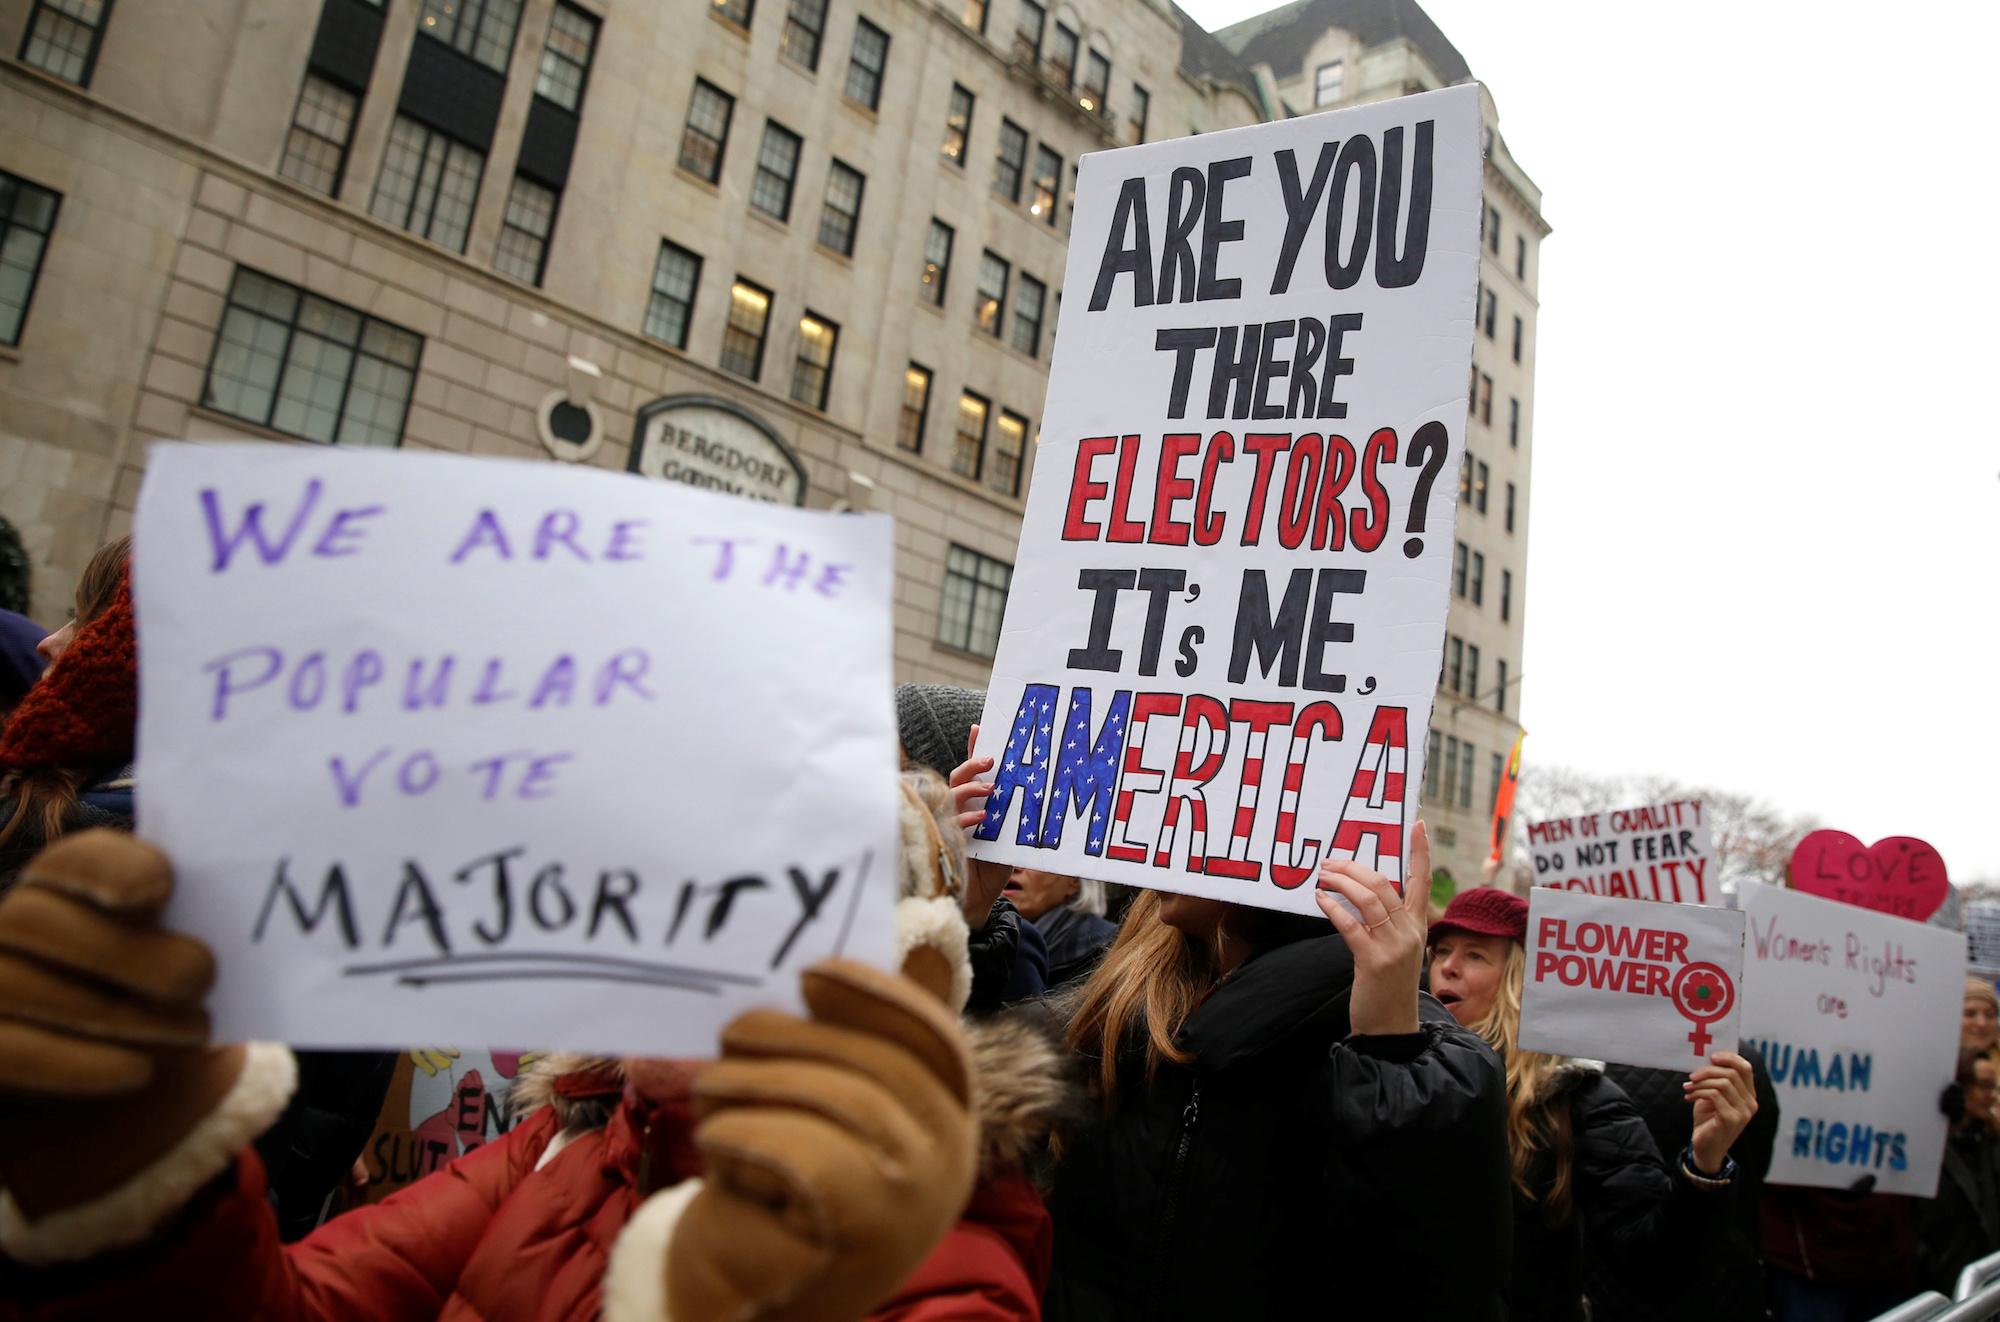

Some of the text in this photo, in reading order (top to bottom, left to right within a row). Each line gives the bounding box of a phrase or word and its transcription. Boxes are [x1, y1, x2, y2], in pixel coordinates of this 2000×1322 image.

[1087, 119, 1435, 312] ARE YOU
[1154, 313, 1363, 420] THERE
[660, 422, 789, 488] BERGDORF
[1061, 420, 1448, 559] ELECTORS?
[199, 476, 852, 598] WE ARE THE
[1227, 568, 1377, 695] ME,
[203, 645, 656, 721] POPULAR
[328, 750, 577, 810] VOTE
[973, 683, 1408, 900] AMERICA
[1526, 800, 1702, 846] MEN OF QUALITY
[1535, 831, 1698, 874] DO NOT FEAR
[1540, 857, 1707, 903] UALITY
[1816, 846, 1932, 885] LOVE
[1538, 917, 1690, 965] FLOWER
[1845, 931, 1917, 998] Rights
[1535, 951, 1672, 998] POWER
[1817, 993, 1848, 1019] are
